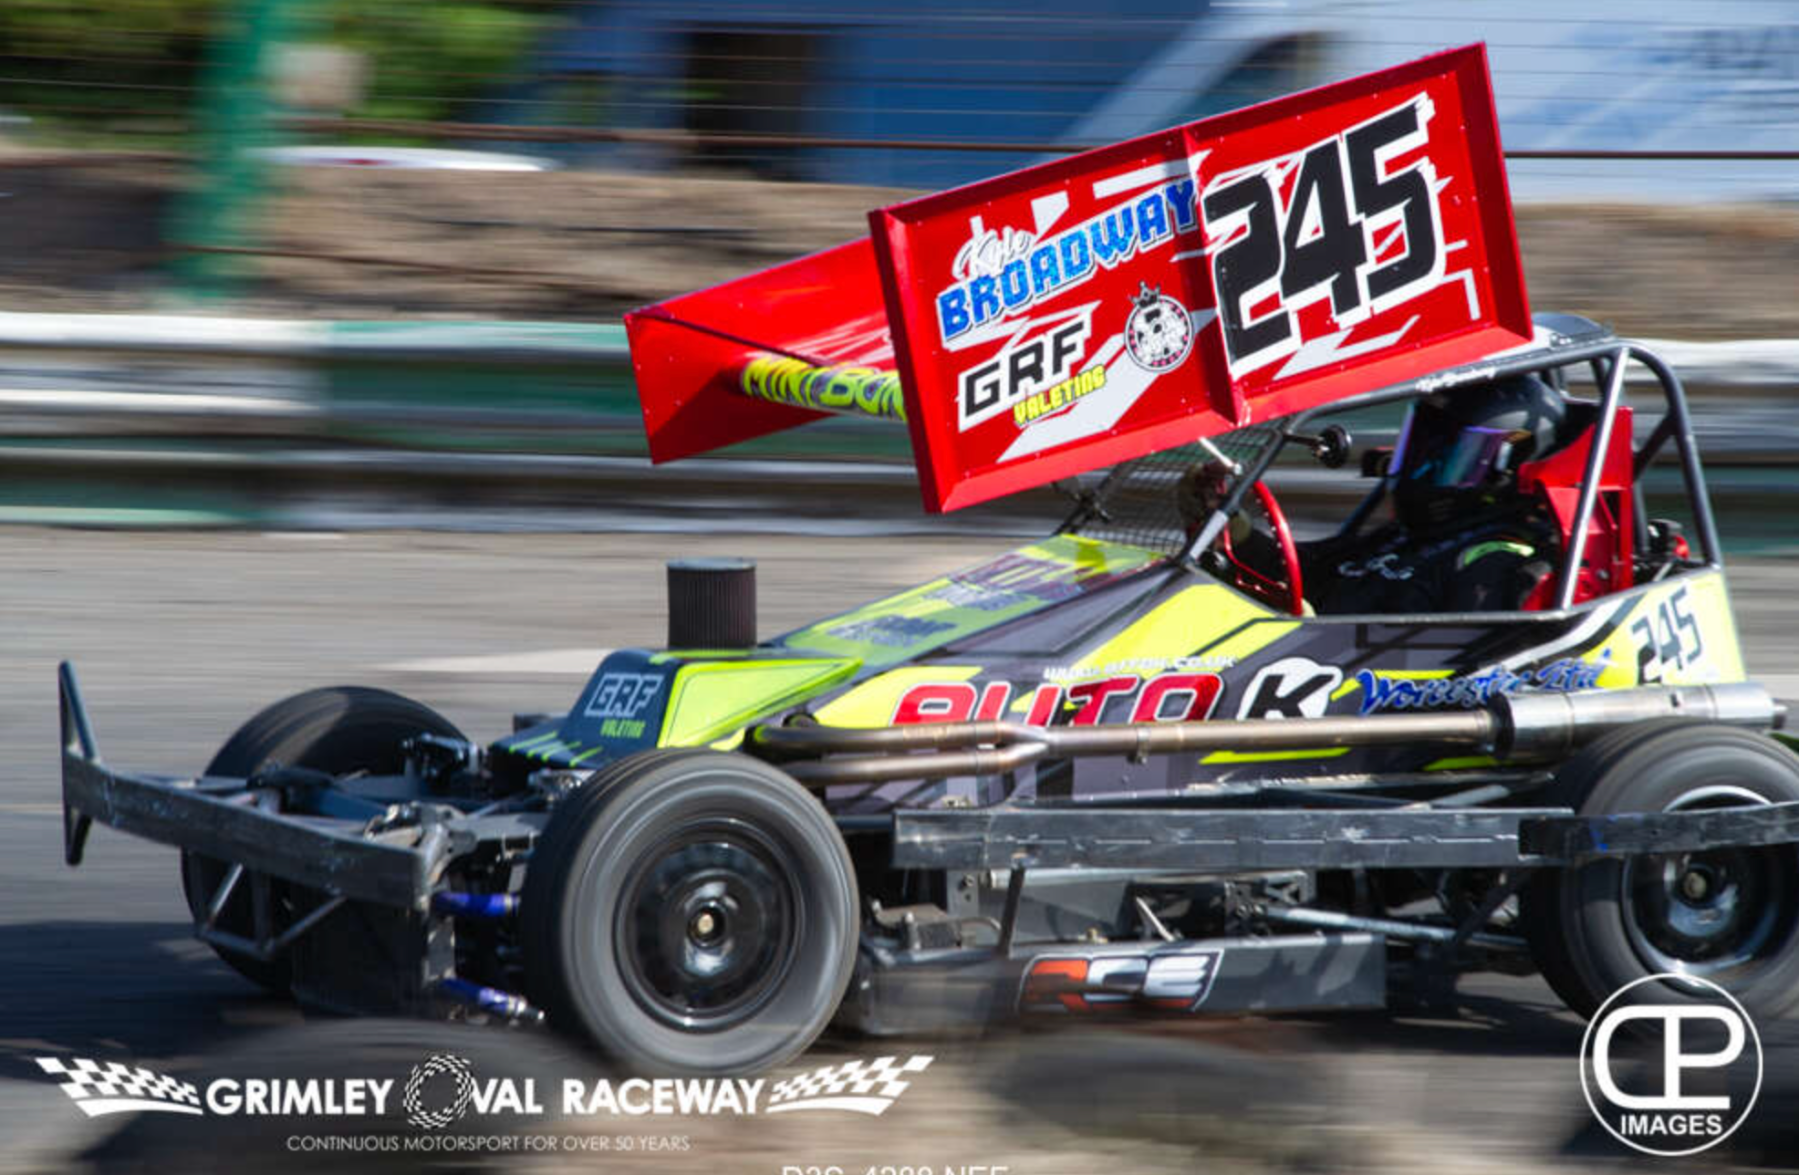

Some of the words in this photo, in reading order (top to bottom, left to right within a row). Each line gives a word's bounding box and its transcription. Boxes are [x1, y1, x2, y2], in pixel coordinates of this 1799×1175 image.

[937, 179, 1198, 340] BROADWAY
[1201, 94, 1433, 371] 245
[962, 314, 1088, 424] GRF
[1013, 365, 1106, 427] VALETING
[1631, 584, 1704, 686] 245
[584, 673, 664, 717] GRF
[1240, 665, 1339, 721] K
